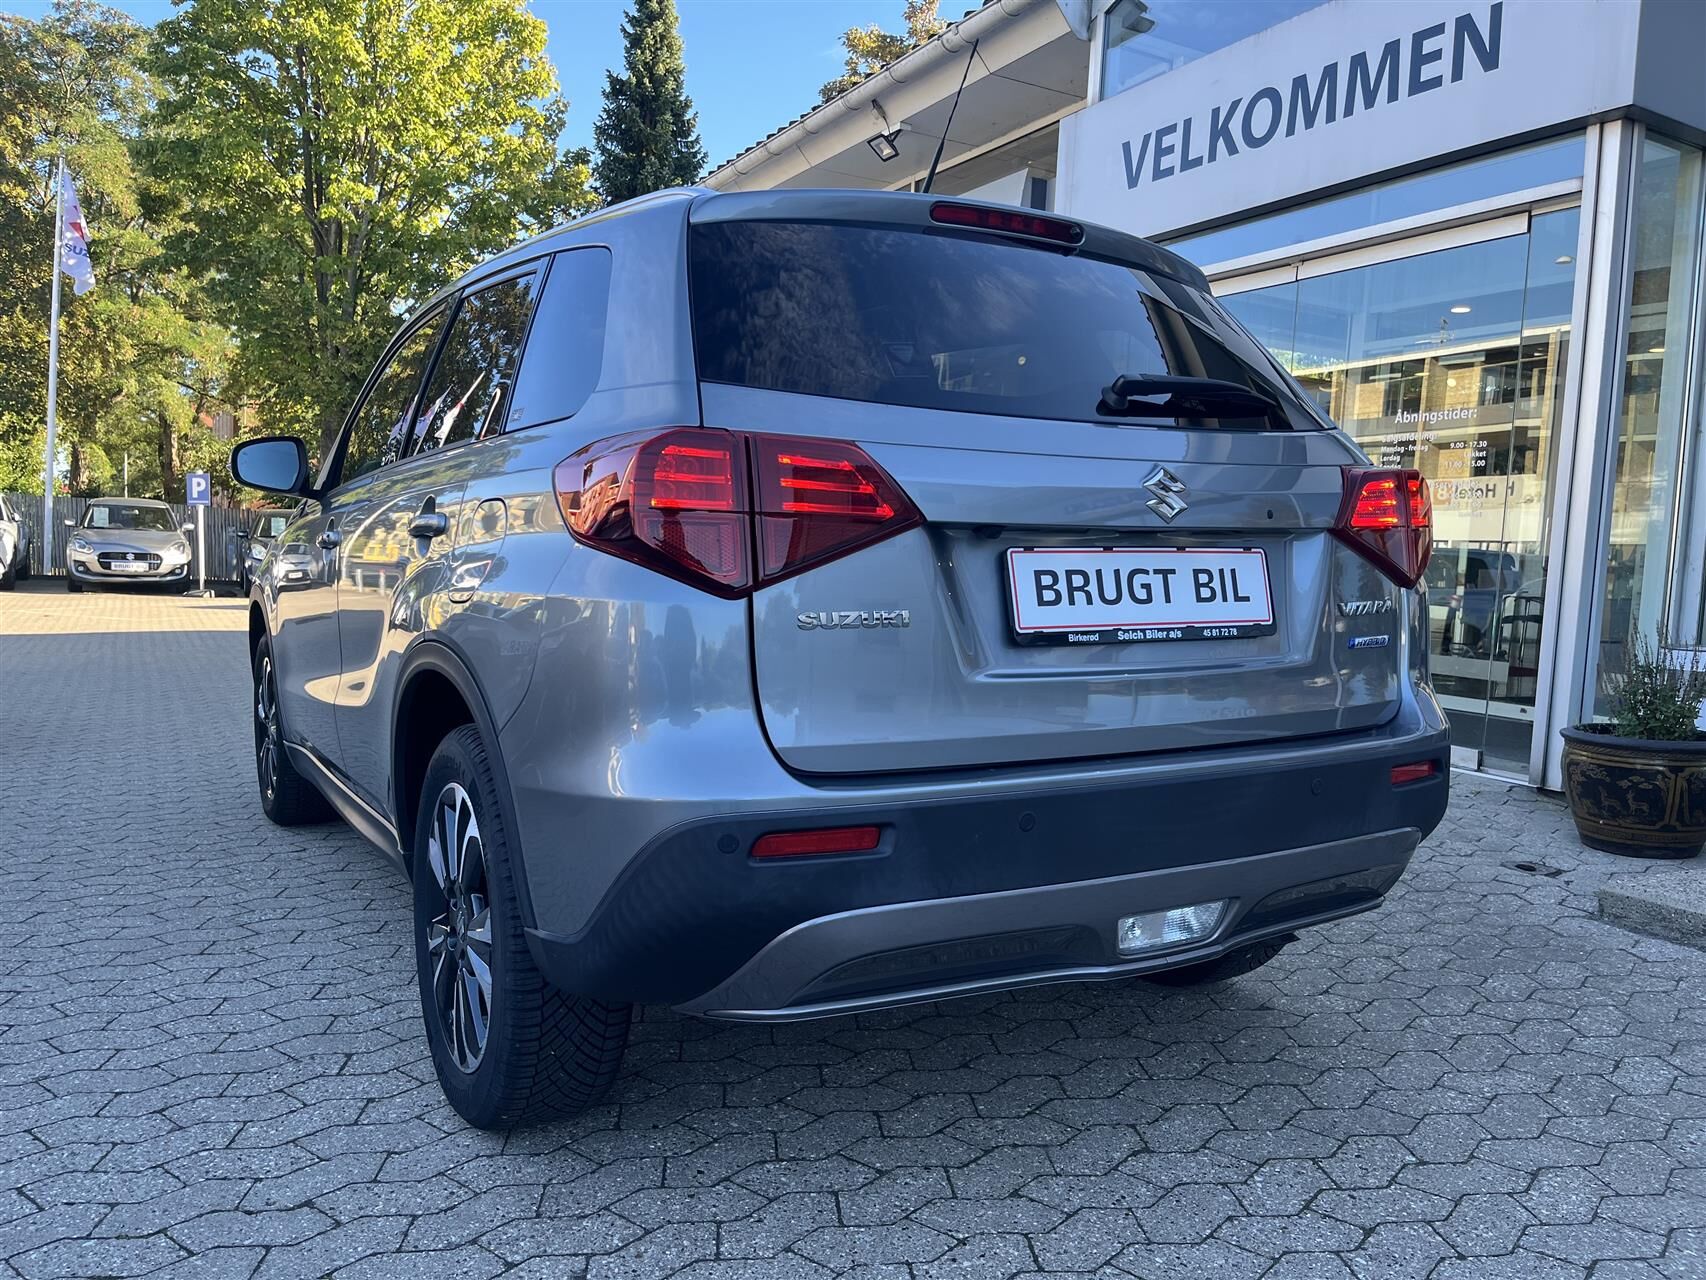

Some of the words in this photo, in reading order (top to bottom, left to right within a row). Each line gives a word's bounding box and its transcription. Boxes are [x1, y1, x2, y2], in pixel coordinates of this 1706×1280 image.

[1121, 3, 1501, 190] VELKOMMEN
[1394, 408, 1478, 424] Åbningstider:
[191, 477, 207, 498] P
[1033, 568, 1176, 607] BRUGT
[1192, 567, 1251, 602] BIL
[1337, 600, 1392, 616] VITARA
[797, 609, 910, 630] SUZUKI
[1117, 630, 1144, 641] Selch
[1145, 629, 1167, 639] Biler
[1169, 629, 1182, 639] a/s
